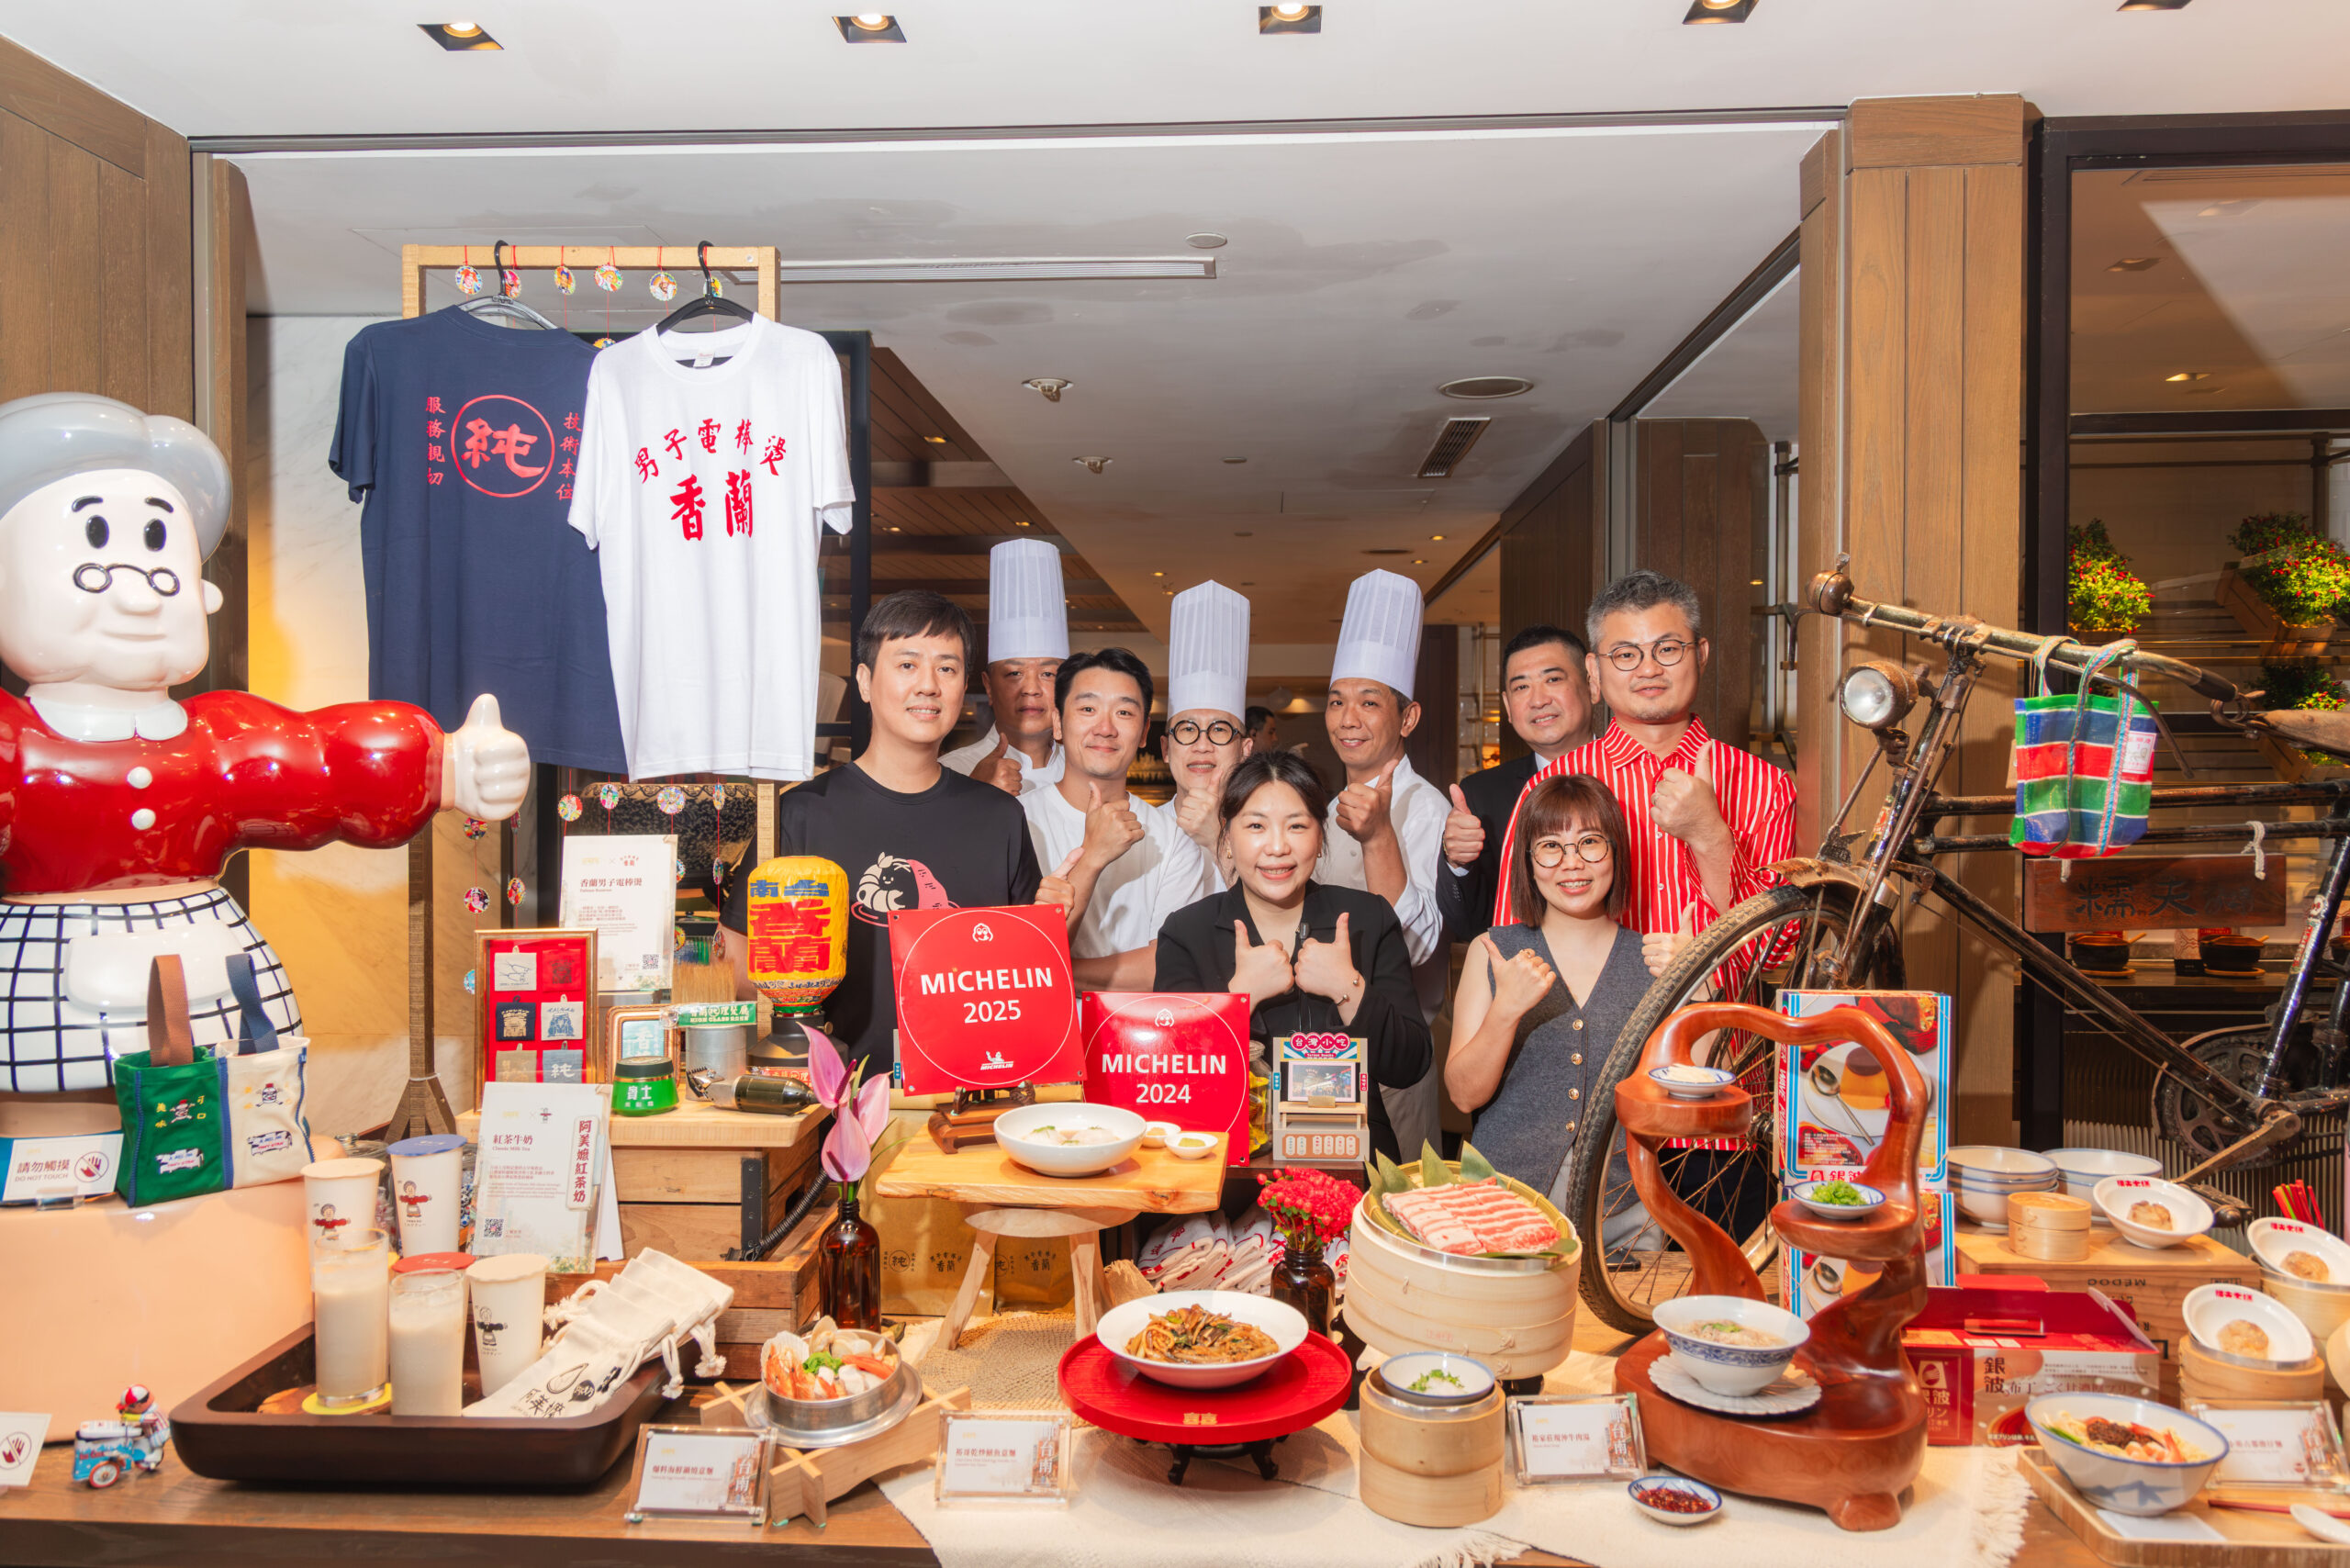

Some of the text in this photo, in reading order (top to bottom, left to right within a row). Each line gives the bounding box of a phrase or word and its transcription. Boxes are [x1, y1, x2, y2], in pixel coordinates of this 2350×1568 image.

[426, 397, 446, 485] 服務親切
[461, 418, 545, 478] 純
[555, 412, 582, 501] 技術本位
[669, 468, 754, 542] 香蘭
[921, 967, 1054, 995] MICHELIN
[962, 1000, 1022, 1024] 2025
[1294, 1036, 1348, 1047] 台灣小吃
[1102, 1053, 1227, 1075] MICHELIN
[1136, 1083, 1192, 1104] 2024
[1779, 1069, 1787, 1102] WAVE
[493, 1134, 532, 1145] 紅茶牛奶
[17, 1159, 71, 1174] 請勿觸摸
[1984, 1356, 2006, 1394] 銀波
